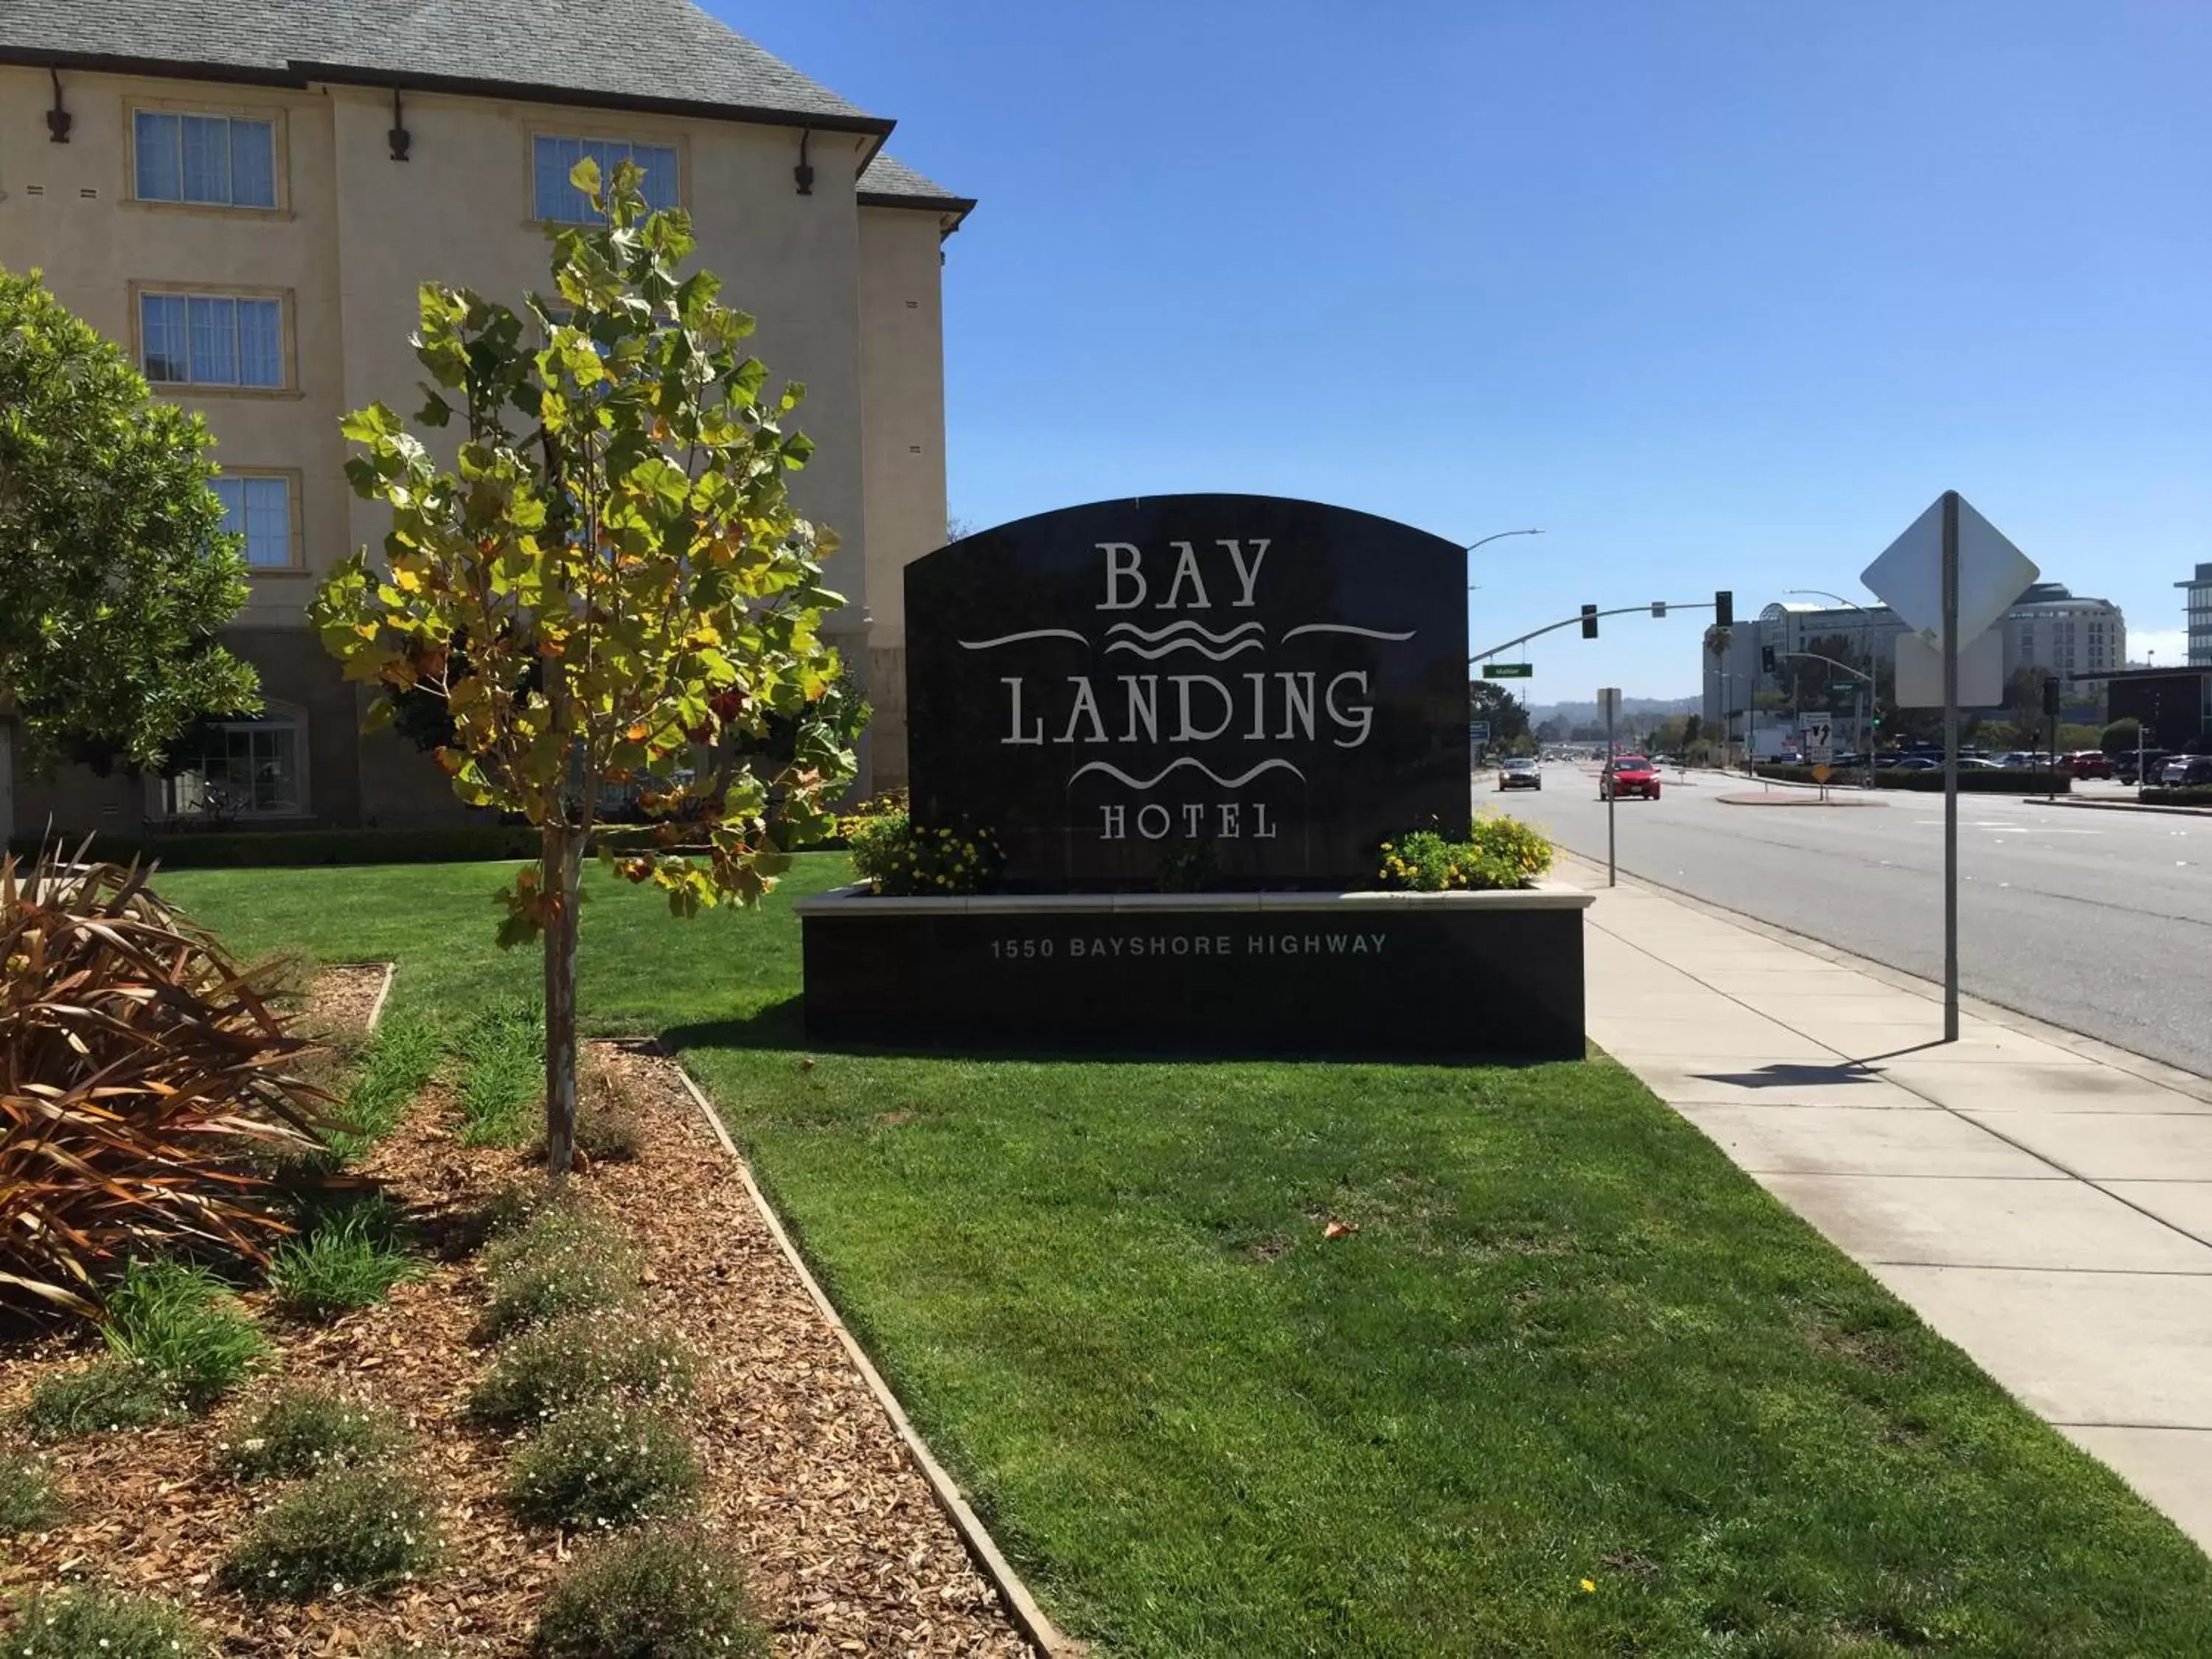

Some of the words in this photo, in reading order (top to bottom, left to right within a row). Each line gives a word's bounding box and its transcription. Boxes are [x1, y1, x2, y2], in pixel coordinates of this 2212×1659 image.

[1096, 539, 1271, 610] BAY
[1001, 671, 1374, 748] LANDING
[1099, 803, 1276, 839] HOTEL
[991, 939, 1053, 958] 1550
[1070, 936, 1231, 957] BAYSHORE
[1248, 933, 1386, 954] HIGHWAY
